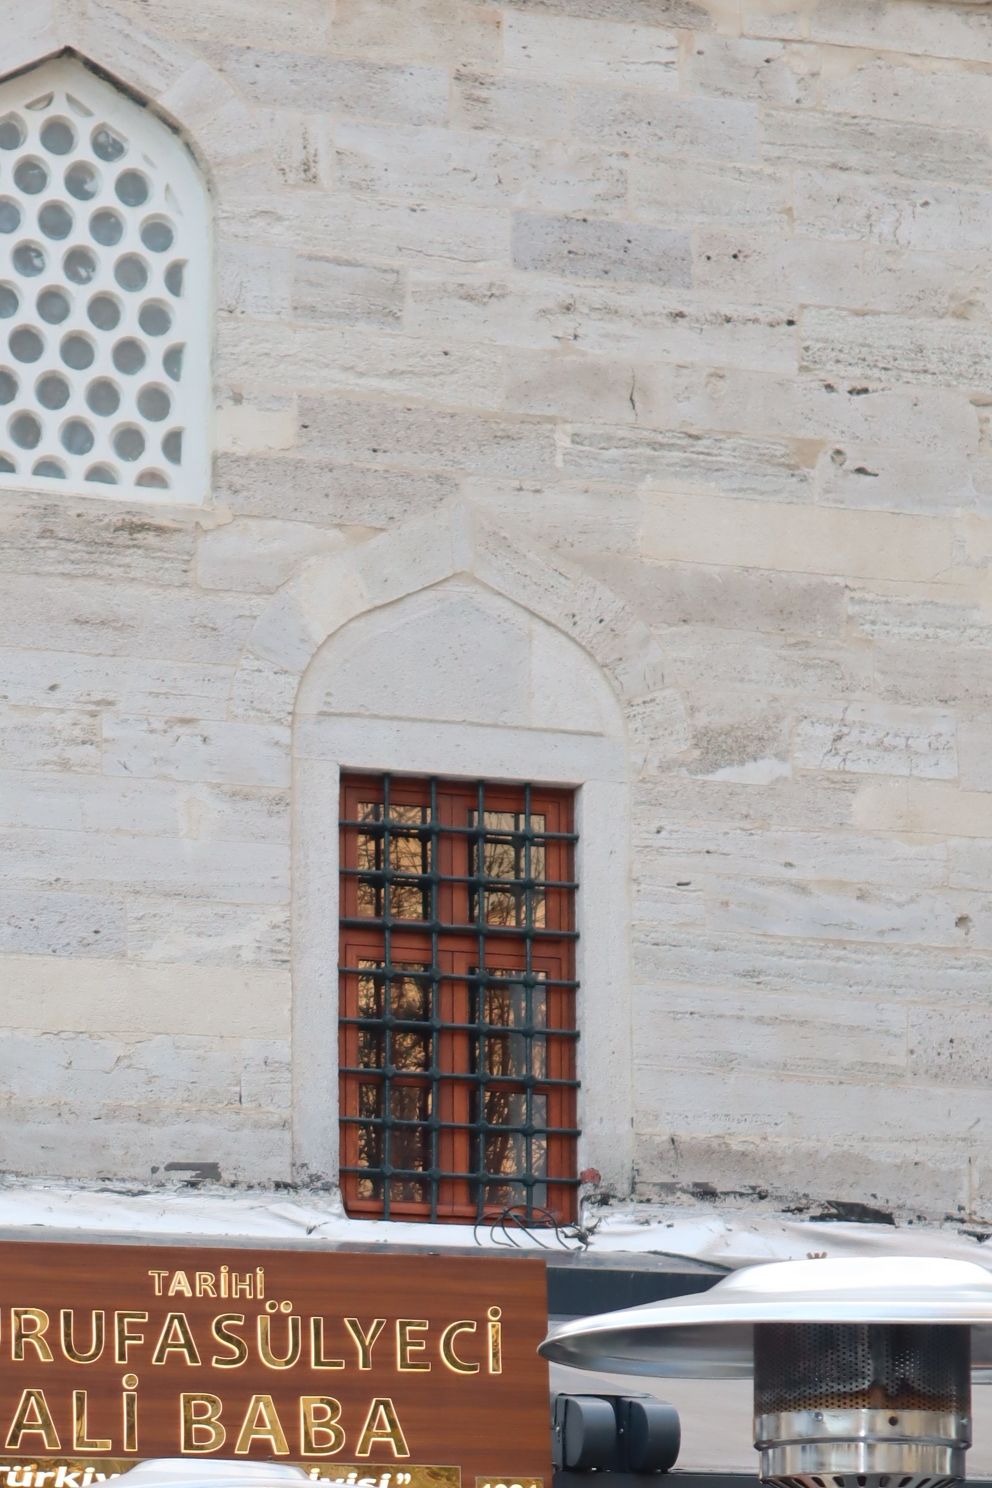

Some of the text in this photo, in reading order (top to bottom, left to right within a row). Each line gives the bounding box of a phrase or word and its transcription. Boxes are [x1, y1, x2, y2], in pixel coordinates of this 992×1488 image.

[148, 1265, 266, 1299] TARİHİ
[5, 1373, 410, 1459] ALİ BABA
